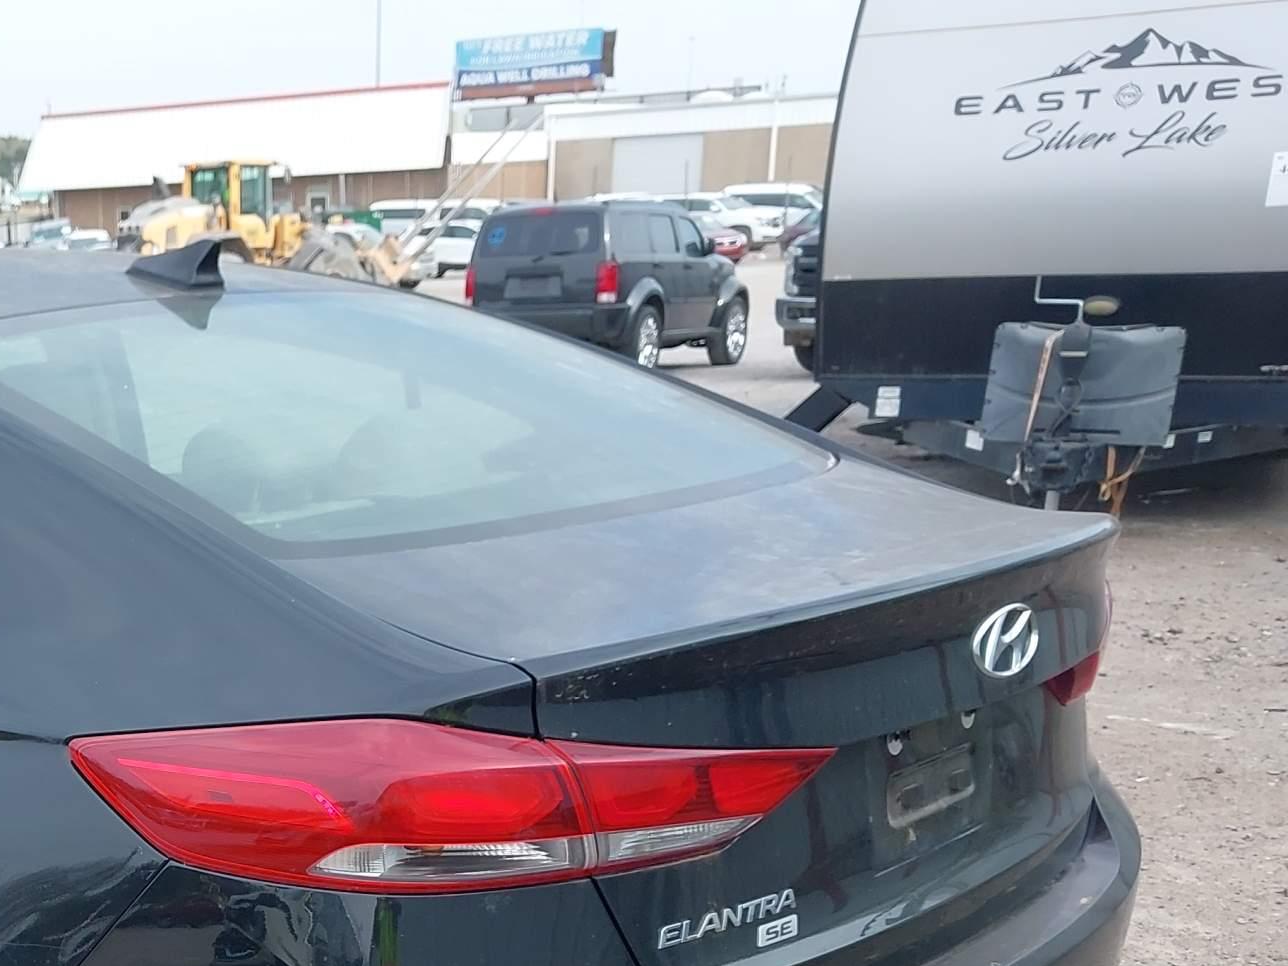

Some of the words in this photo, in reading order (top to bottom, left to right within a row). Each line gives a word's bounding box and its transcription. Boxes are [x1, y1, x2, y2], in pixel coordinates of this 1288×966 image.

[482, 37, 523, 53] FREE
[529, 30, 589, 49] WATER
[497, 70, 528, 84] WELL
[531, 63, 590, 80] DRILLING
[953, 89, 1101, 116] EAST
[1002, 119, 1116, 161] Silver
[1122, 111, 1227, 158] Lake
[657, 888, 797, 950] ELANTRA
[765, 920, 793, 942] SE
